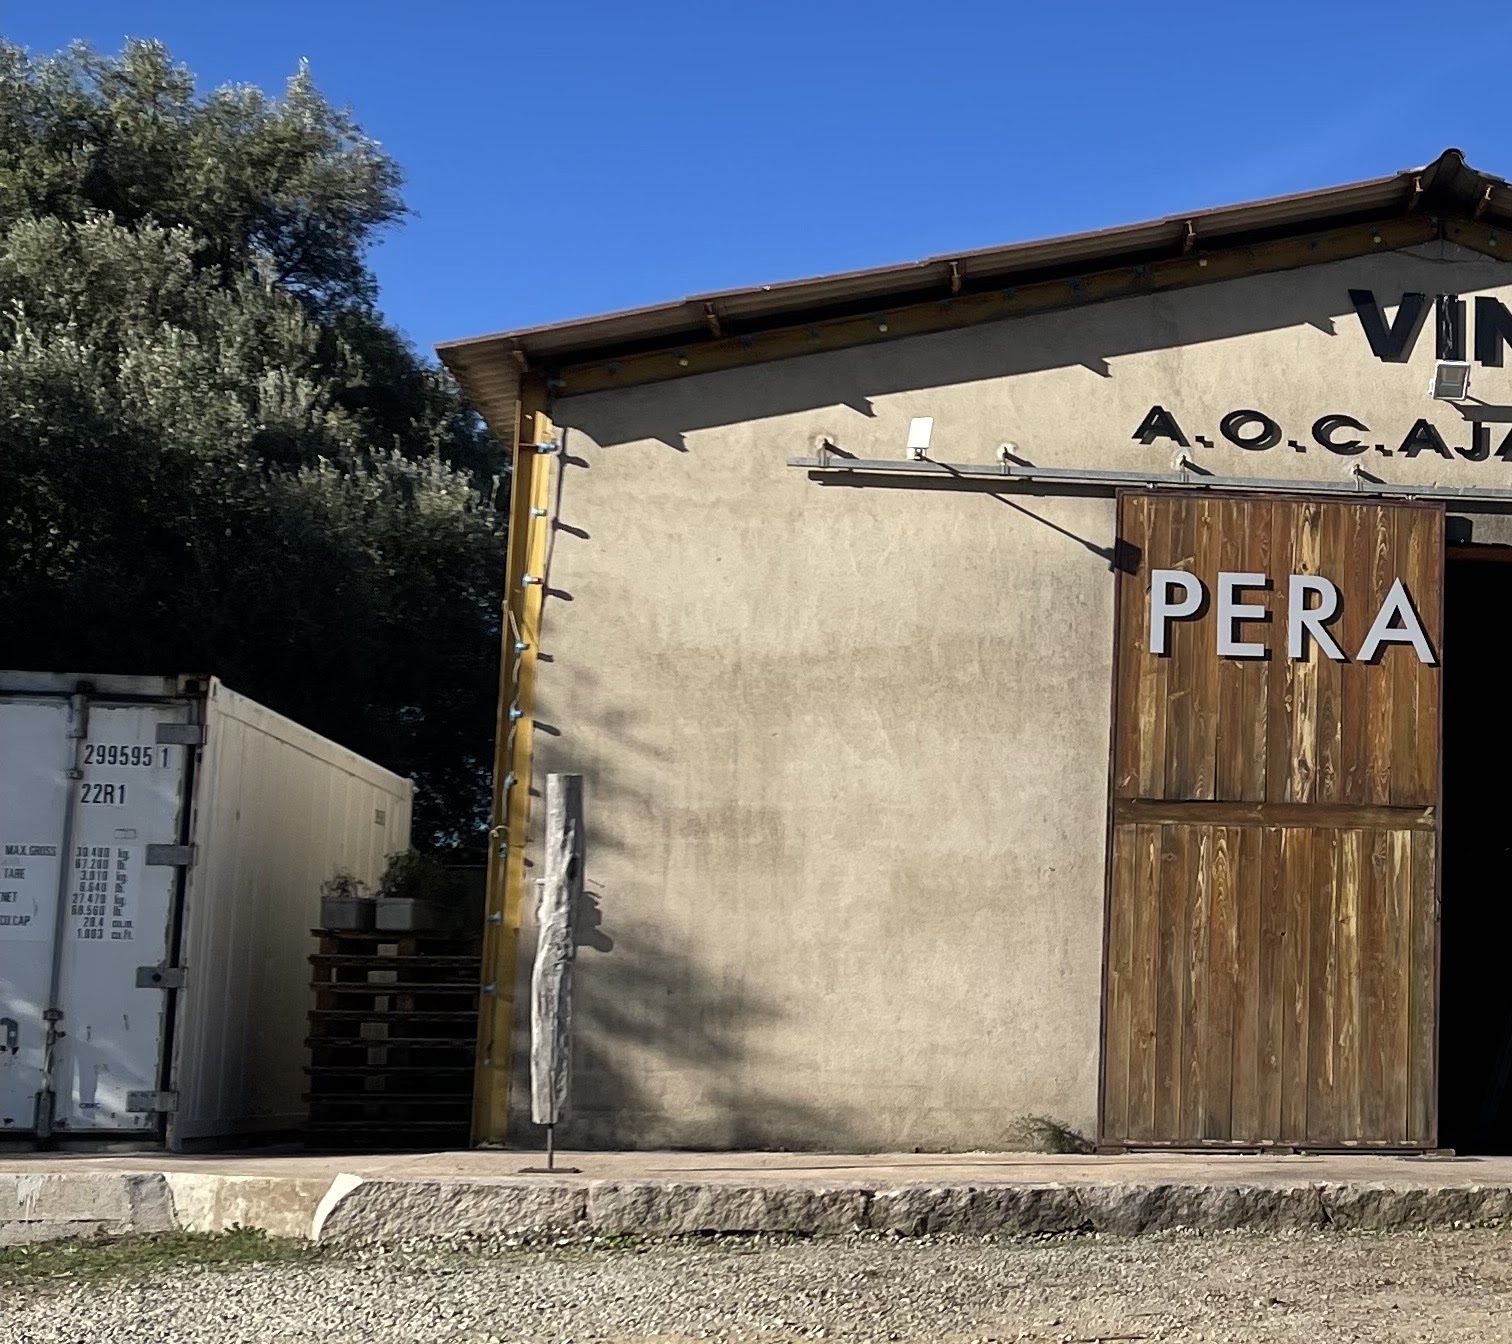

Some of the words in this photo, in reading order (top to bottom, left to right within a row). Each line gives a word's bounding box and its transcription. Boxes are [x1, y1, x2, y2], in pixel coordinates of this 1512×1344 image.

[1149, 569, 1437, 663] PERA
[84, 745, 152, 766] 299595
[81, 783, 125, 804] 22R1
